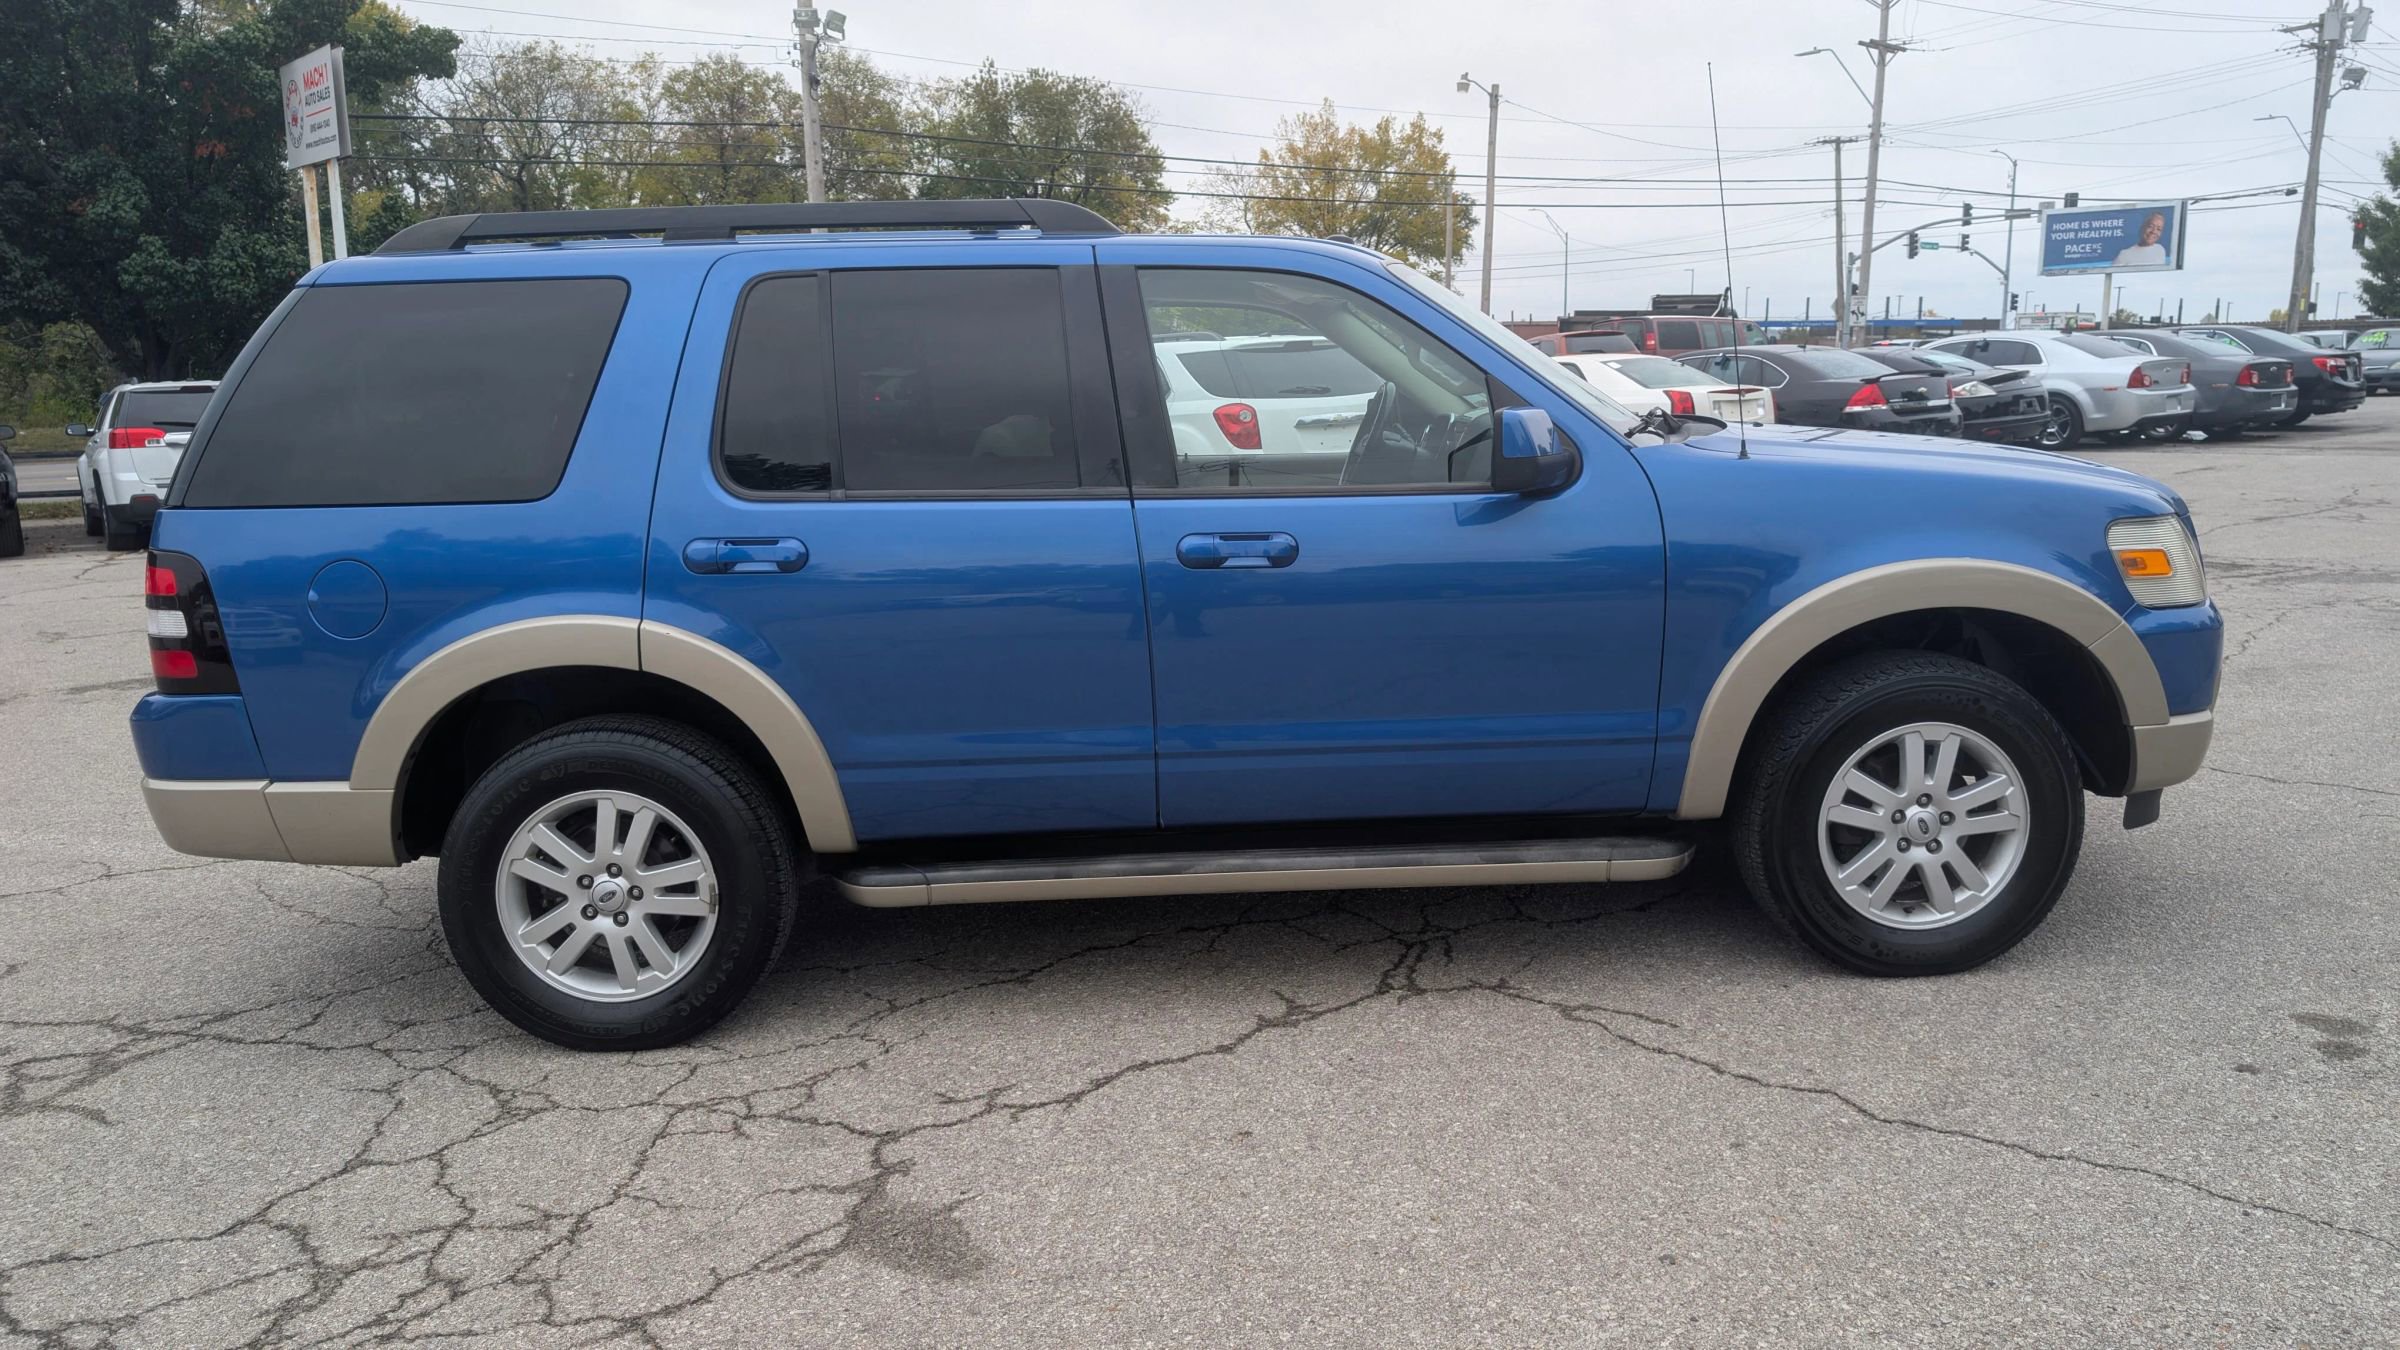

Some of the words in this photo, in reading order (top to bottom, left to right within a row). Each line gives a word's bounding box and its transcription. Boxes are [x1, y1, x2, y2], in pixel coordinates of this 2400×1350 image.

[303, 65, 324, 91] MACH
[305, 91, 317, 107] AUTO
[317, 86, 330, 103] SALES
[2053, 221, 2079, 231] HOME
[2081, 220, 2089, 229] IS
[2091, 219, 2124, 228] WHERE
[2051, 231, 2075, 241] YOUR
[2078, 230, 2111, 239] HEALTH
[2113, 229, 2124, 237] IS.
[2064, 243, 2092, 254] PACE
